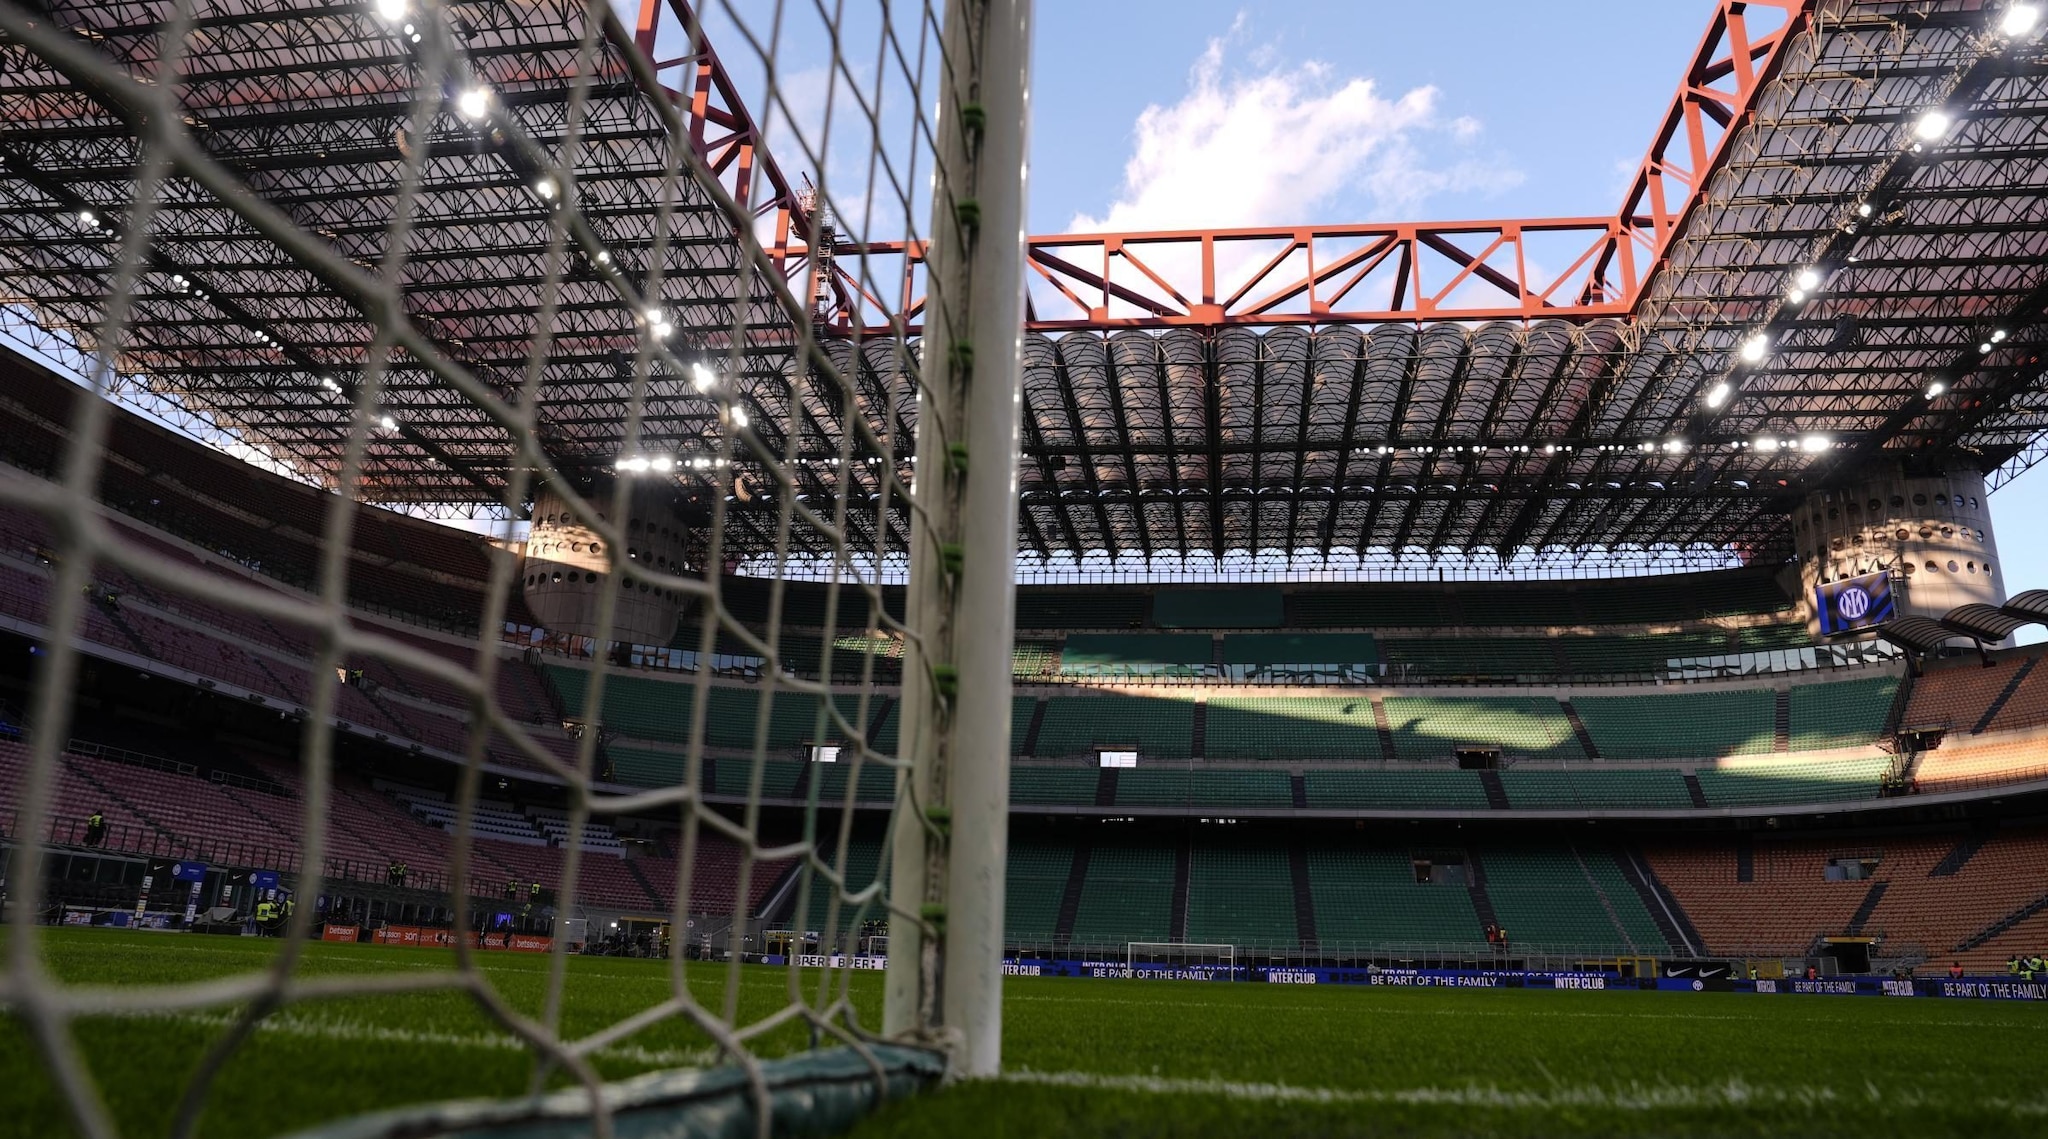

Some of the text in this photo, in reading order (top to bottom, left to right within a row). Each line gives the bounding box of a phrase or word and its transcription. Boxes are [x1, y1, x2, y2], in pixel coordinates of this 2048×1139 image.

[329, 927, 354, 935] betsson
[516, 939, 540, 949] betsson
[1020, 965, 1041, 976] CLUB
[1093, 968, 1215, 981] BE PART OF THE FAMILY
[1268, 972, 1316, 984] INTER CLUB
[1371, 975, 1497, 987] BE PART OF THE FAMILY
[1555, 977, 1605, 989] INTER CLUB
[1794, 981, 1857, 994] BE PART OF THE FAMILY
[1898, 980, 1914, 996] CLUB
[1944, 983, 2048, 999] BE PART OF THE FAMILY
